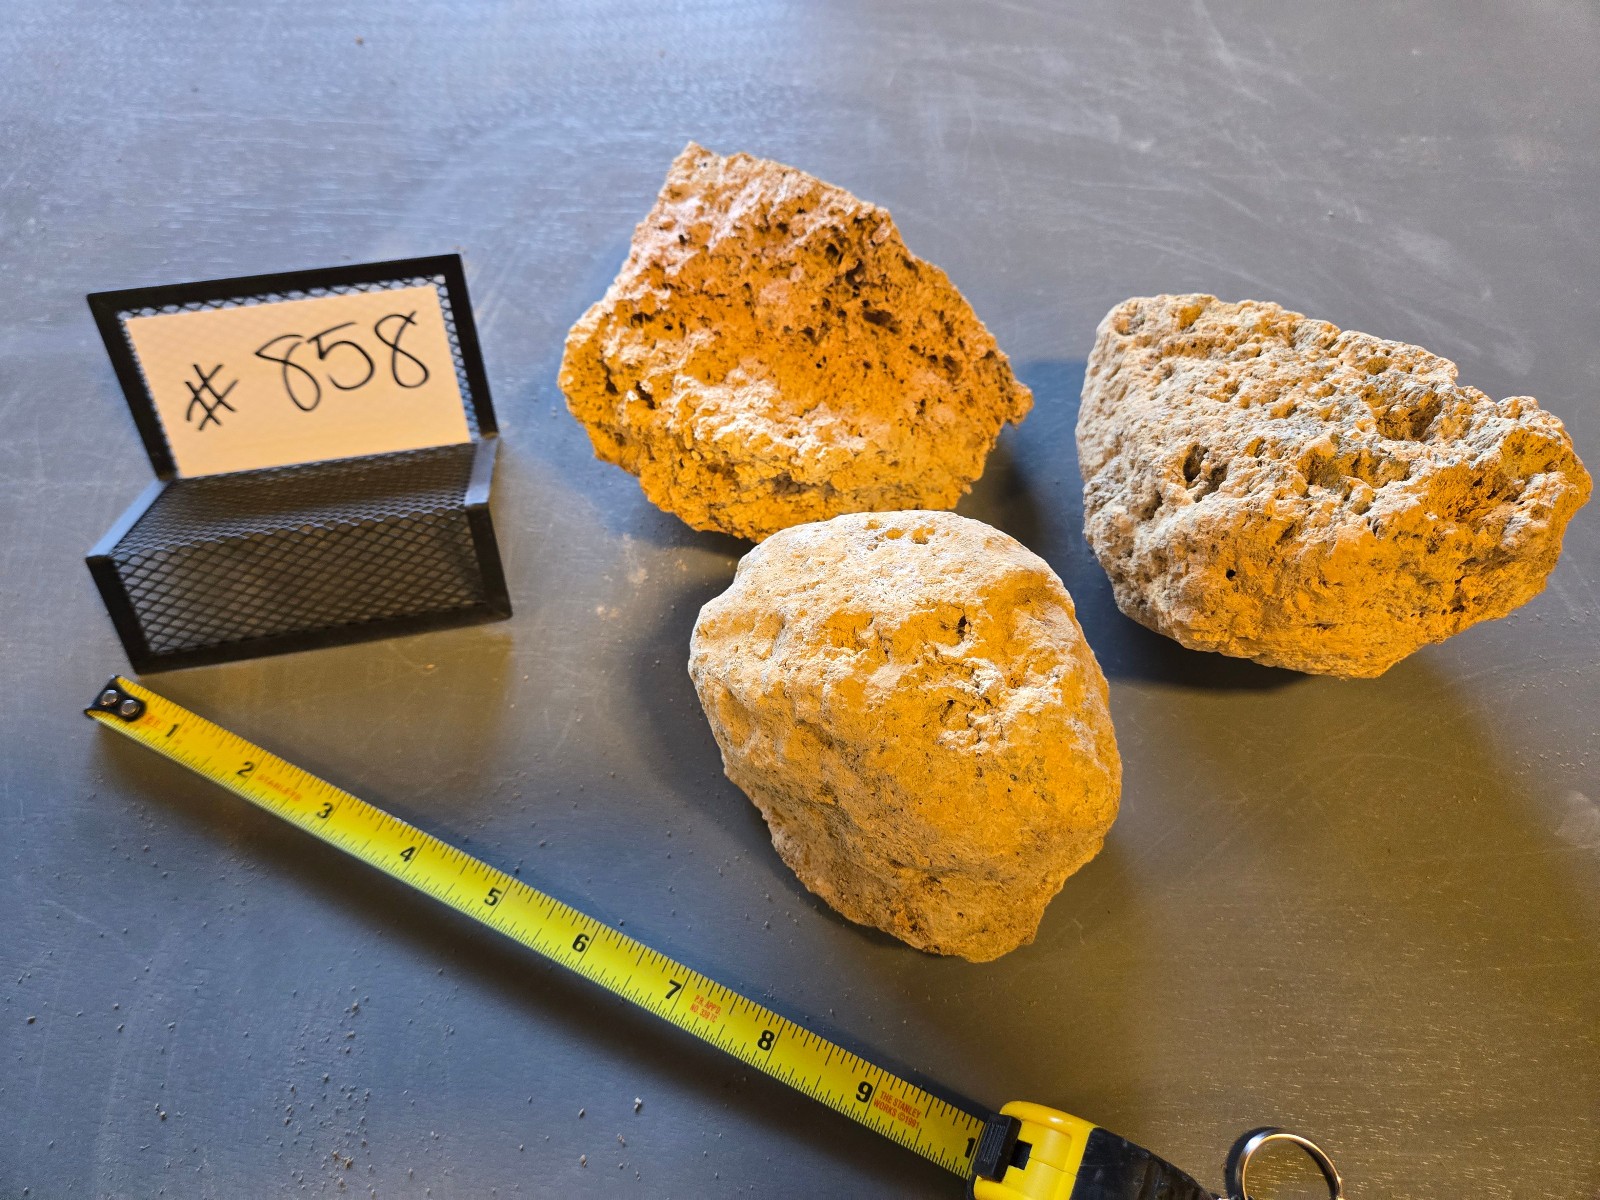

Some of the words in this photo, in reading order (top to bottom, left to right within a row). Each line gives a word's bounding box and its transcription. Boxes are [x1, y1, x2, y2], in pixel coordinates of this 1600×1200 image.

[185, 363, 239, 431] #
[254, 310, 430, 412] 858
[166, 723, 180, 738] 1
[236, 760, 255, 778] 2
[316, 801, 334, 819] 3
[399, 845, 417, 863] 4
[484, 887, 502, 907] 5
[572, 933, 590, 953] 6
[665, 978, 682, 1000] 7
[757, 1029, 775, 1051] 8
[855, 1081, 873, 1102] 9
[873, 1098, 898, 1117] WORKS
[880, 1090, 893, 1104] THE
[892, 1097, 922, 1119] STANLEY
